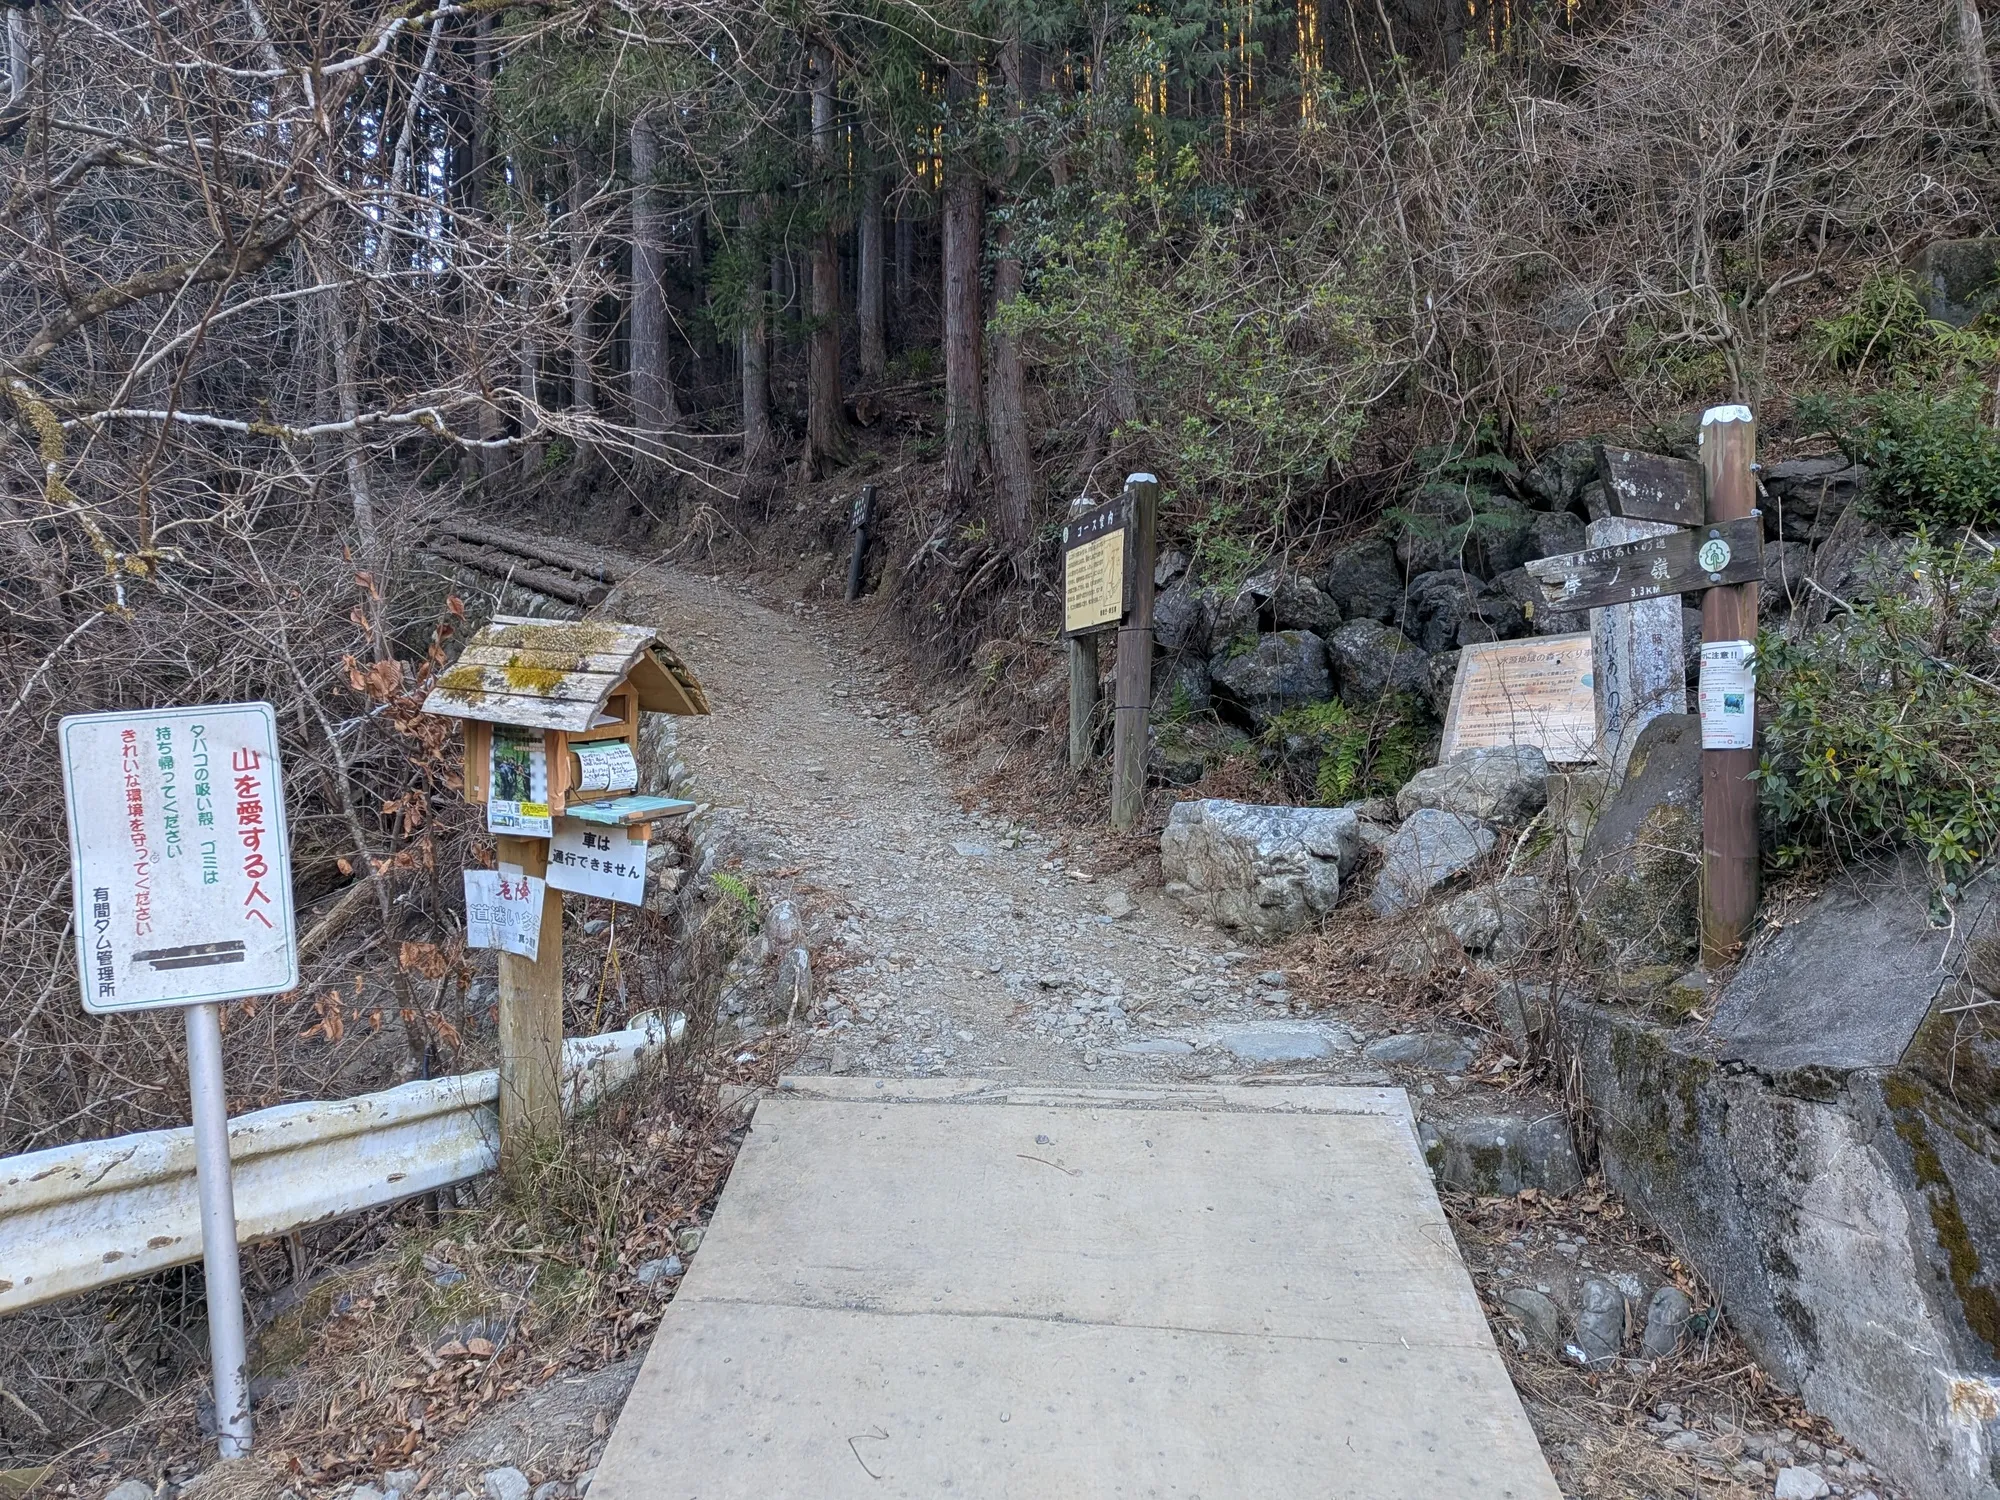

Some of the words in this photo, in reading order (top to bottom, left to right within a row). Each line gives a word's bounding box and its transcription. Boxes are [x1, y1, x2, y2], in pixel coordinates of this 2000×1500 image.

[1077, 510, 1114, 538] コース案内
[120, 728, 152, 937] きれいな環境を守ってください
[155, 726, 183, 859] 持ち帰ってください
[189, 724, 219, 885] タバコの吸い殻、ゴミは
[231, 747, 273, 930] 山を愛する人へ
[582, 831, 611, 852] 車は
[496, 879, 531, 904] 危険
[552, 848, 641, 880] 通行できません
[92, 887, 116, 998] 有間ダム管理所
